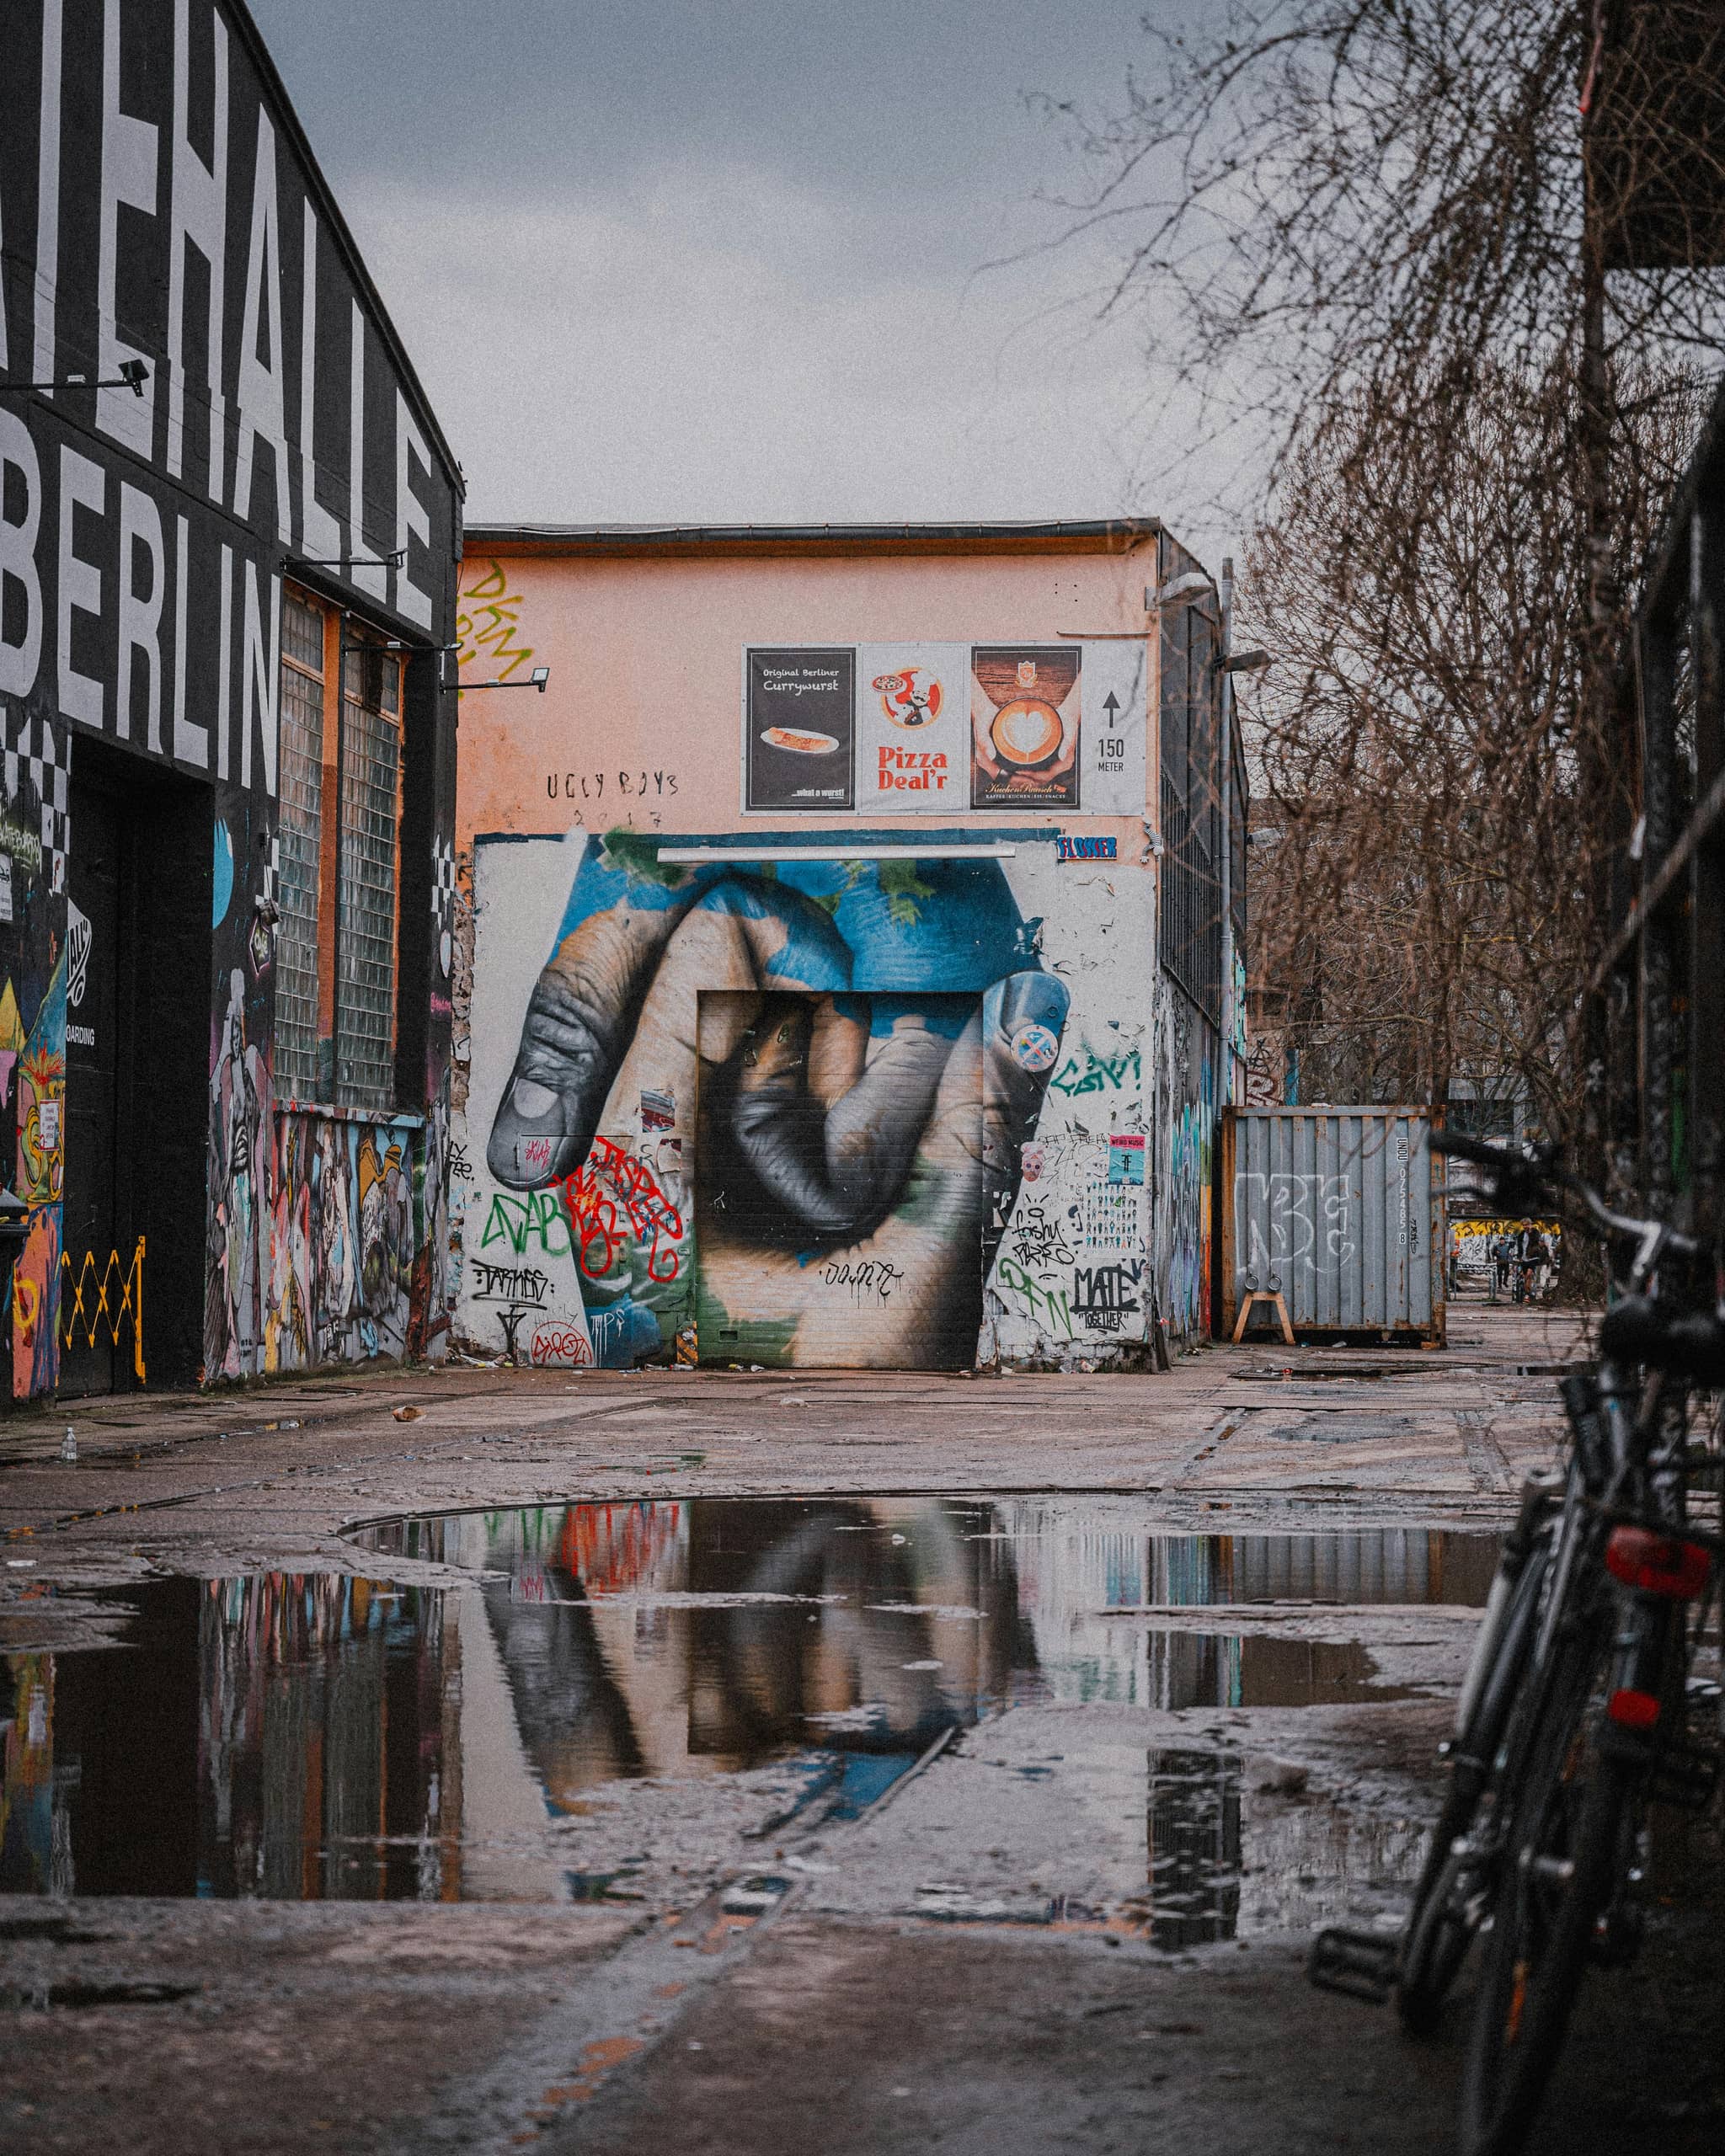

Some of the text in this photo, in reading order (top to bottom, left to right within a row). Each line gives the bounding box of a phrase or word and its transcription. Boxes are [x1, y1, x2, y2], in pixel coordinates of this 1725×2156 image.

[0, 406, 280, 798] BERLIN
[763, 669, 840, 678] Original Berliner
[763, 680, 839, 696] Currywurst
[878, 746, 948, 768] Pizza
[1098, 739, 1124, 757] 150
[1098, 762, 1124, 772] METER
[547, 773, 604, 798] UGLY
[878, 769, 948, 790] Deal'r
[821, 788, 845, 798] wurst!
[1057, 836, 1117, 858] FLOWER
[1128, 1138, 1144, 1147] MUSIC
[1397, 1139, 1407, 1161] UNDU
[1400, 1233, 1406, 1244] 8
